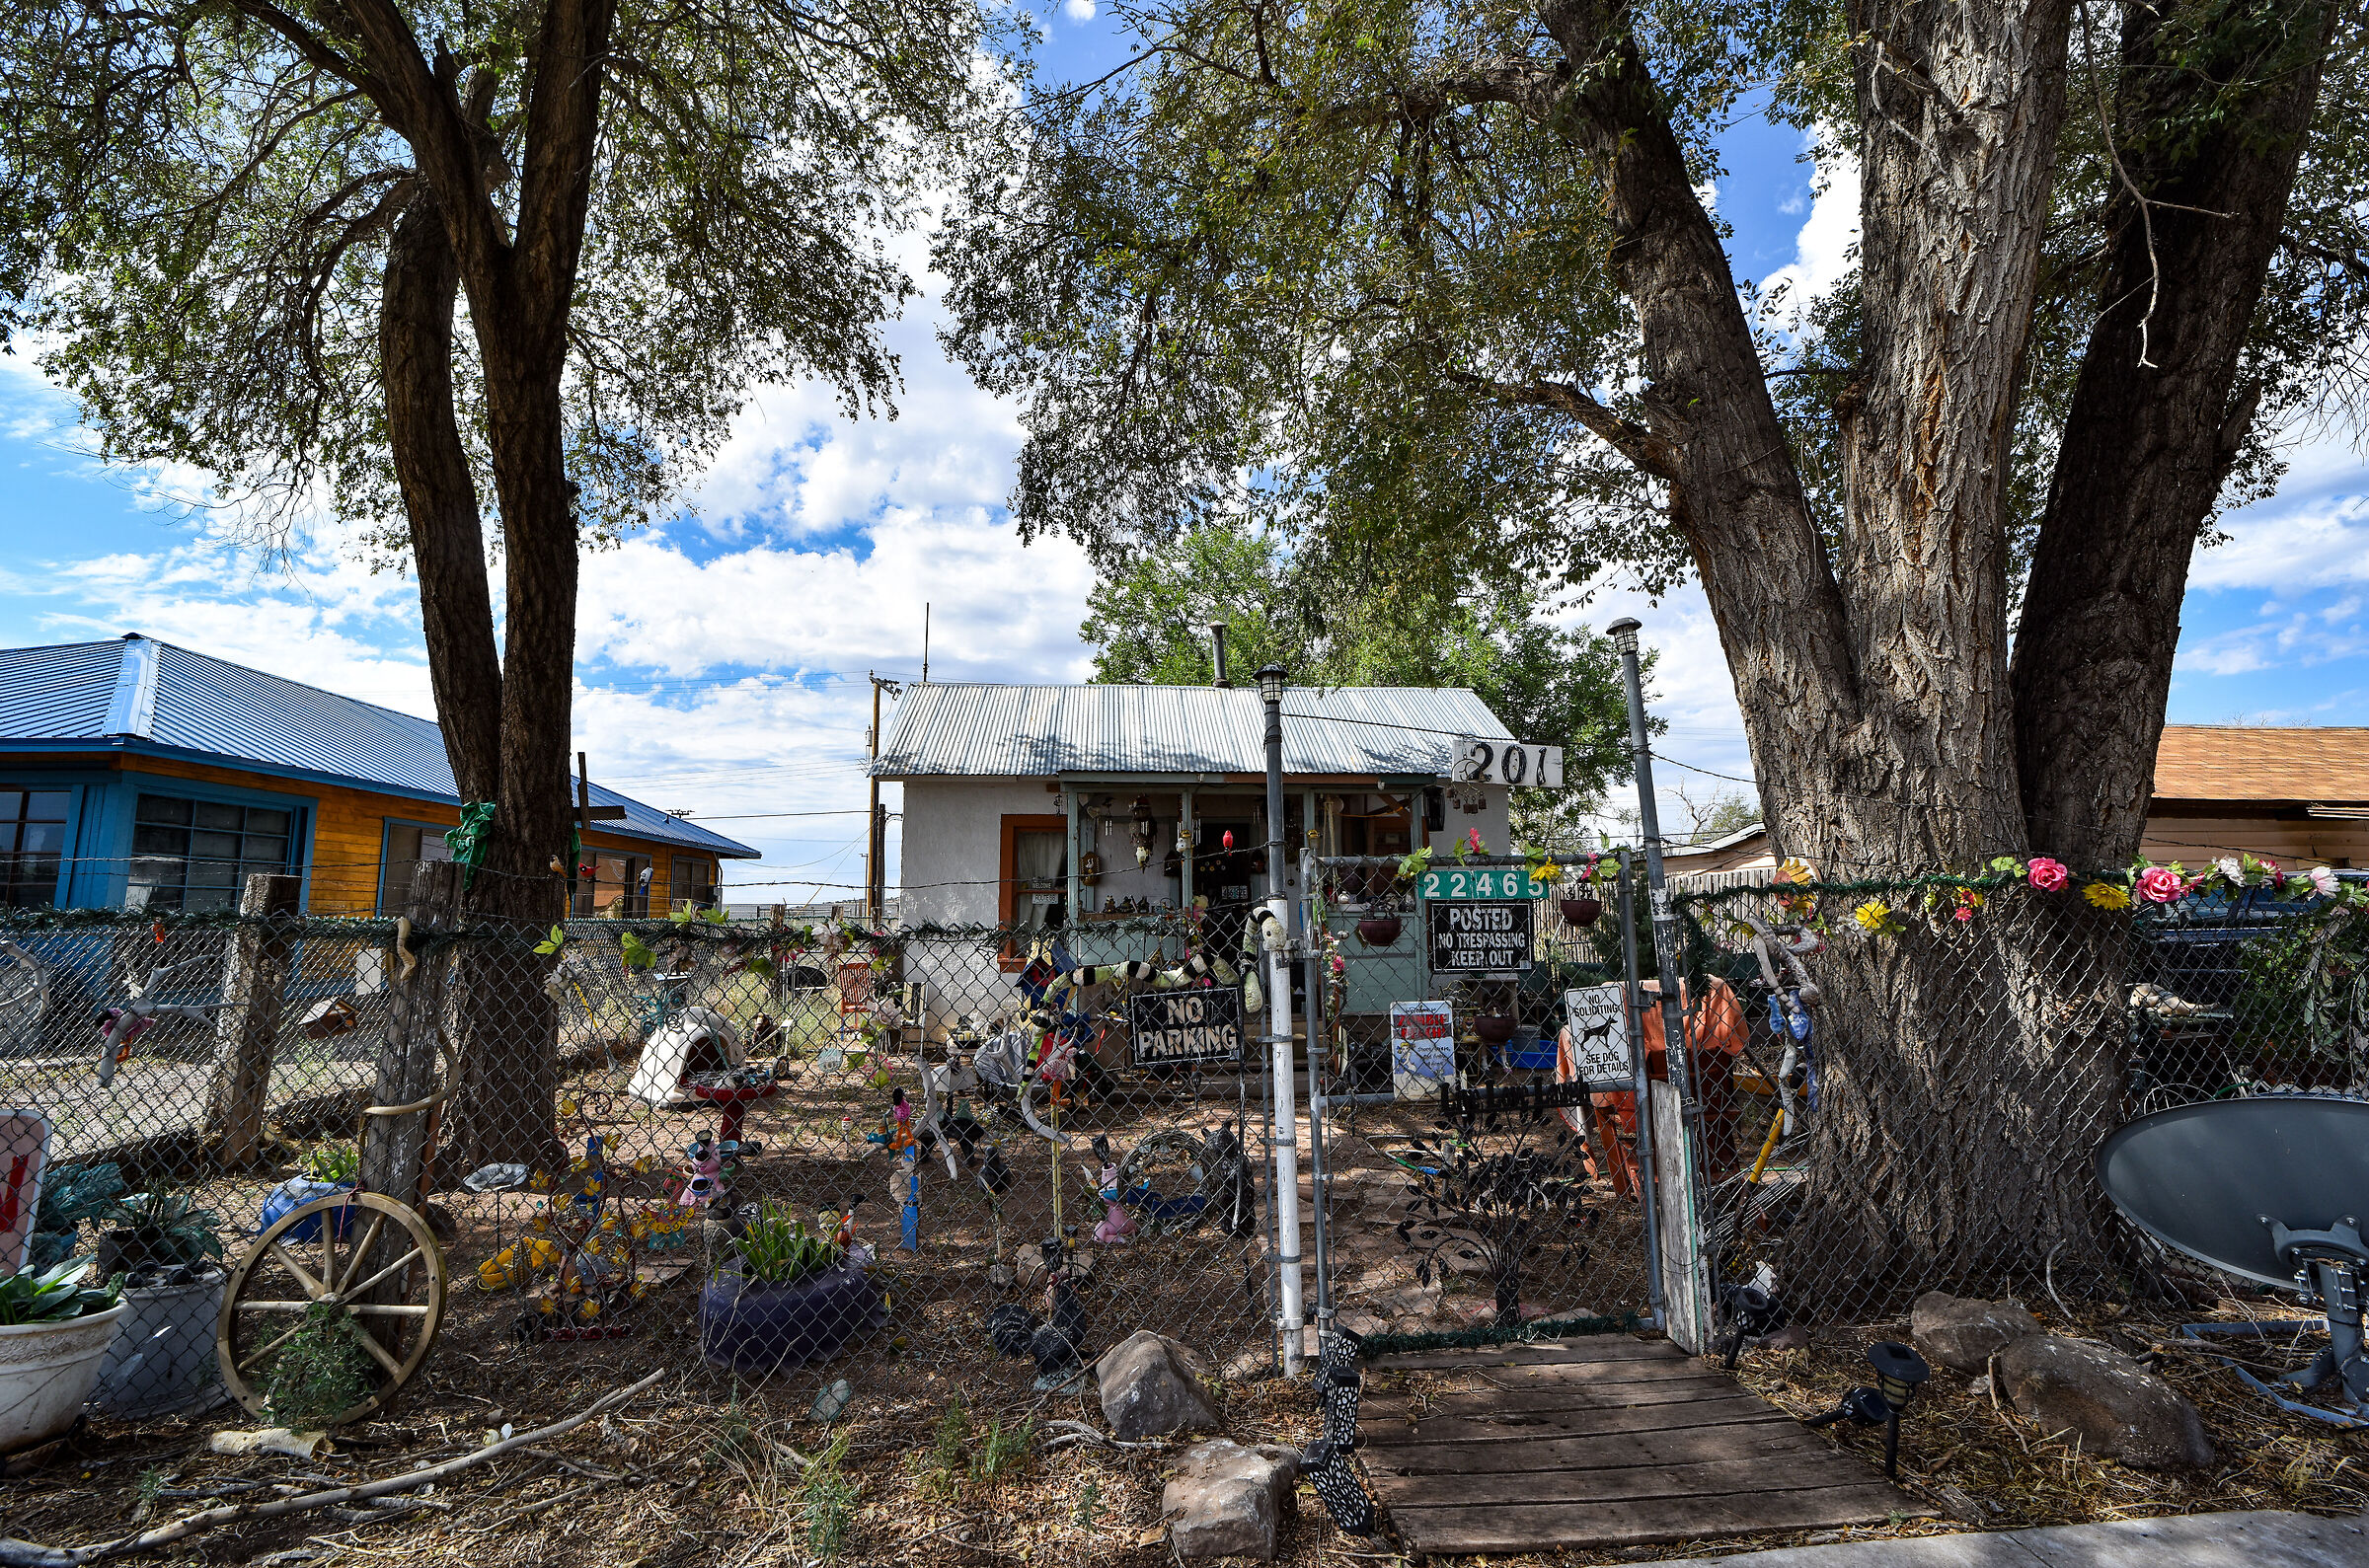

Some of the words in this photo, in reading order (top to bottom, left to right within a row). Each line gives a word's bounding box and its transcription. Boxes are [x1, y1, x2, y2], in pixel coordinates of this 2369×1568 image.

[1466, 742, 1548, 786] 201
[1423, 872, 1544, 897] 22465
[1449, 908, 1513, 931] POSTED
[1438, 933, 1453, 948] NO
[1457, 932, 1526, 948] TRESPASSING
[1451, 950, 1485, 967] KEEP
[1489, 950, 1514, 967] OUT
[1588, 994, 1600, 1006] NO
[1167, 997, 1204, 1025] NO
[1574, 1004, 1618, 1017] SOLICITING
[1397, 1013, 1448, 1027] ZOMBIE
[1138, 1024, 1238, 1058] PARKING
[1585, 1053, 1601, 1065] SEE
[1602, 1051, 1620, 1063] DOG
[1579, 1065, 1595, 1077] FOR
[1596, 1061, 1630, 1075] DETAILS
